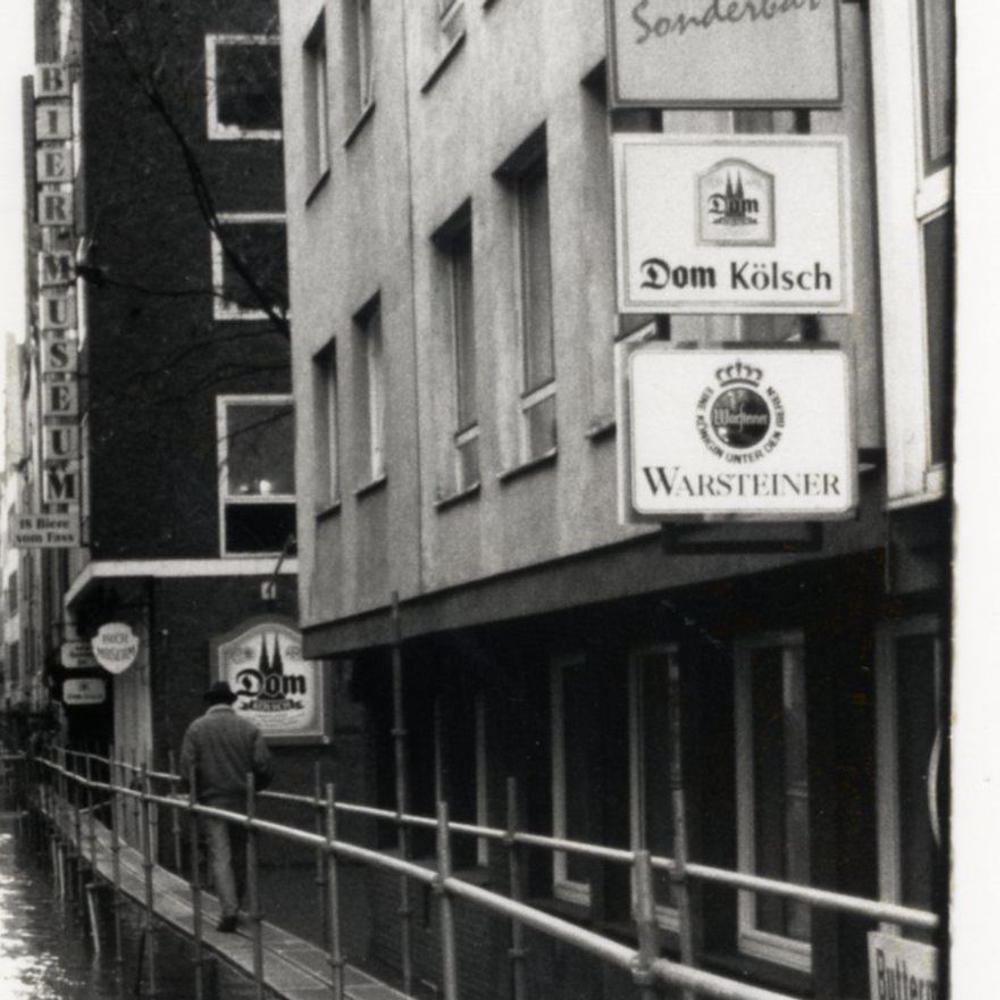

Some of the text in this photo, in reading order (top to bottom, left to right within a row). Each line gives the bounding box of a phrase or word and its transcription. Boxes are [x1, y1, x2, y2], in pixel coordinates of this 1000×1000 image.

[706, 192, 759, 217] Dom
[40, 66, 77, 500] BIER MUSEUM
[640, 257, 832, 291] Dom Kölsch
[643, 466, 840, 496] WARSTEINER
[236, 668, 306, 697] Dom
